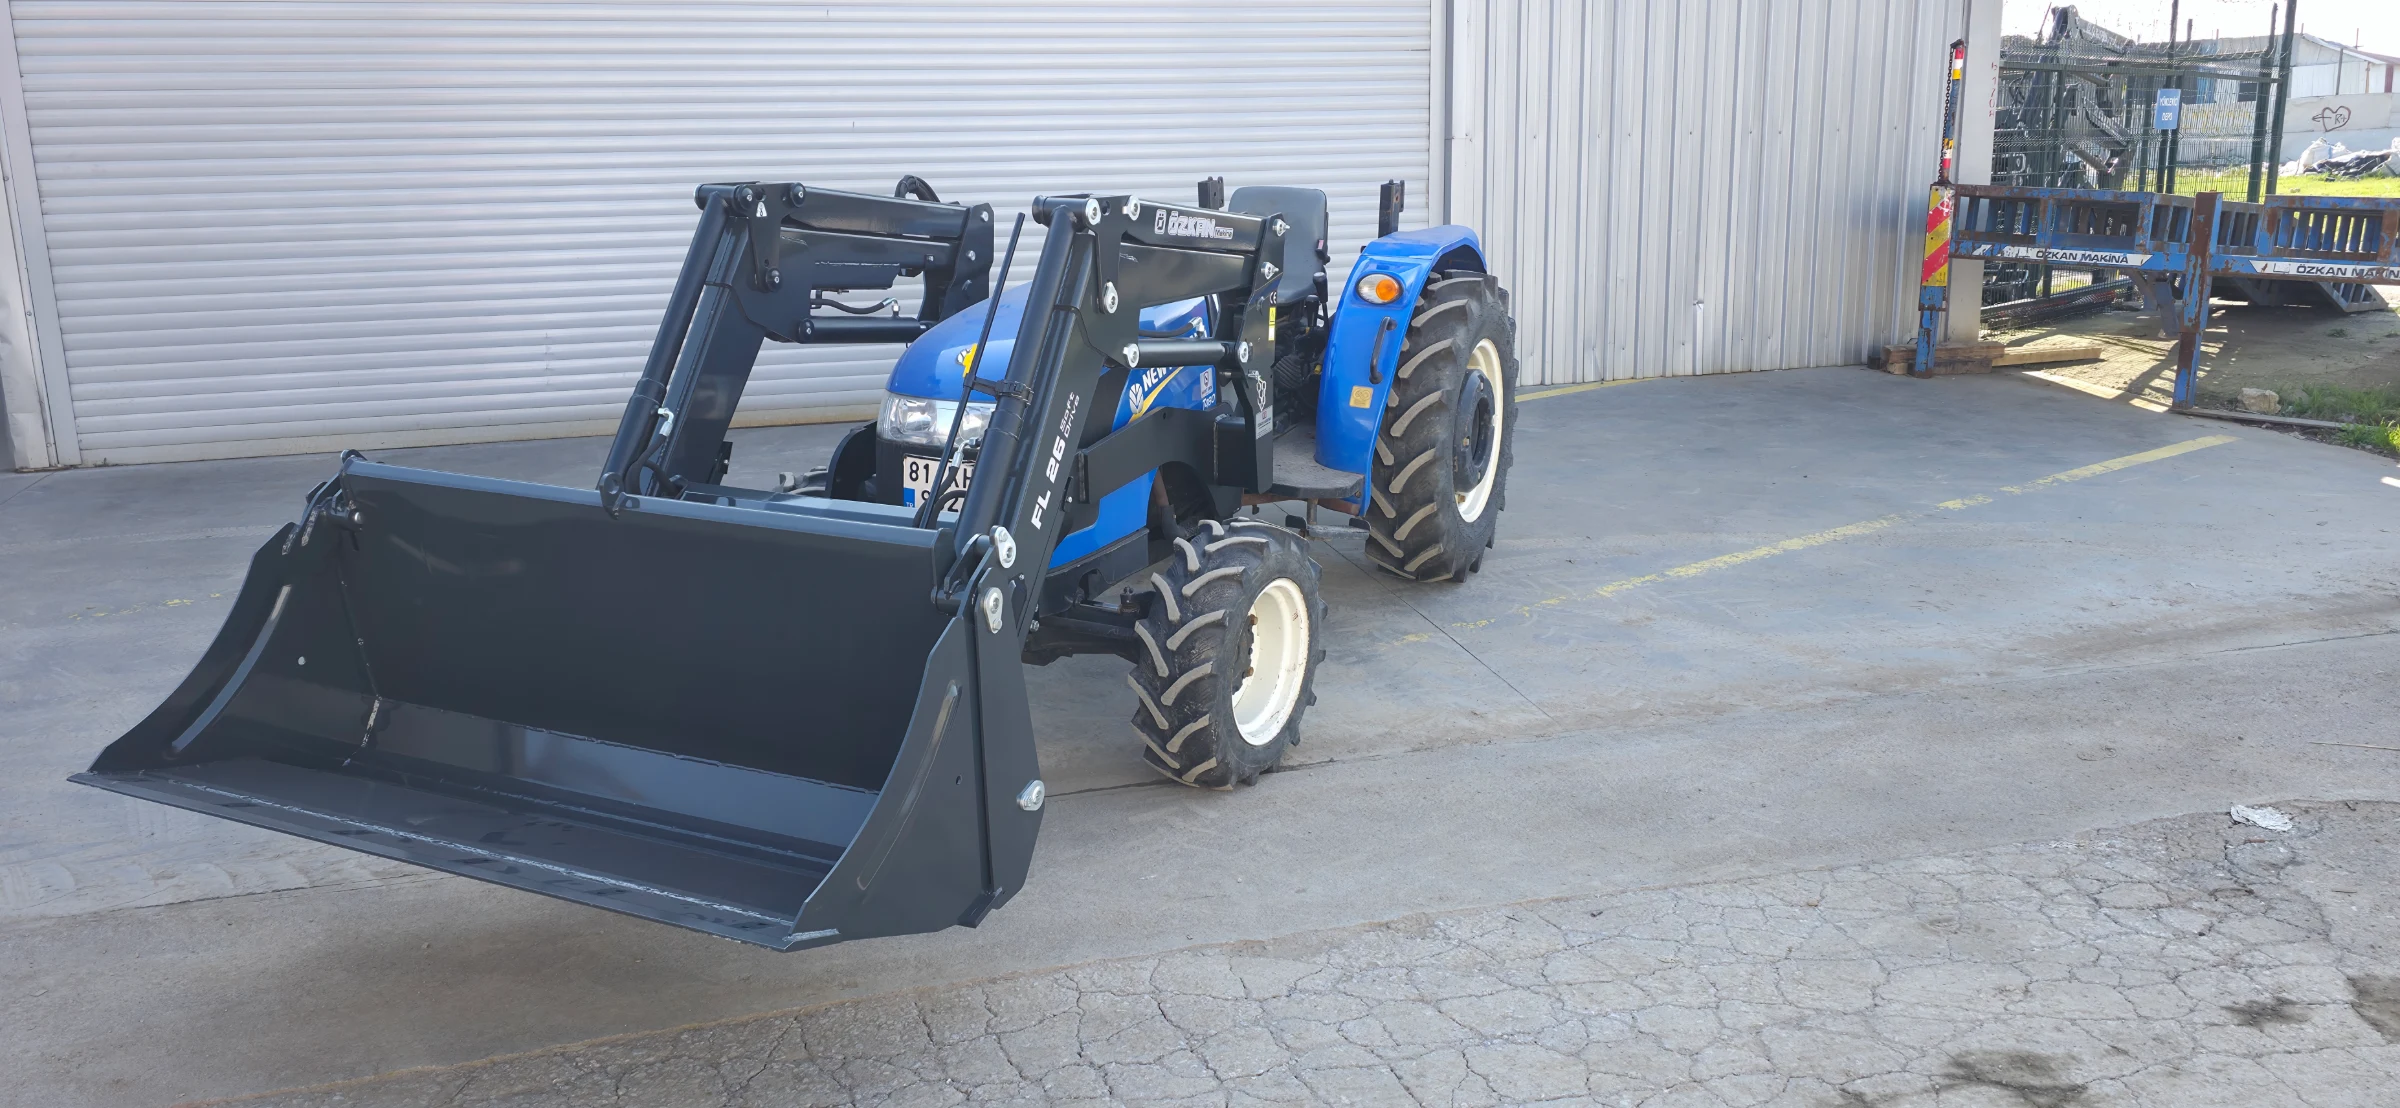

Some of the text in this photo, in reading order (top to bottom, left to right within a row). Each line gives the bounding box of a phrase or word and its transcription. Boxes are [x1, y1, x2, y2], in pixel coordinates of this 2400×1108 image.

[2161, 112, 2173, 121] DEPO
[1167, 210, 1216, 238] ÖZKAN
[2296, 263, 2348, 276] ÖZKAN
[1142, 367, 1167, 392] NEW
[909, 461, 930, 483] 81
[1031, 435, 1066, 530] FL 26
